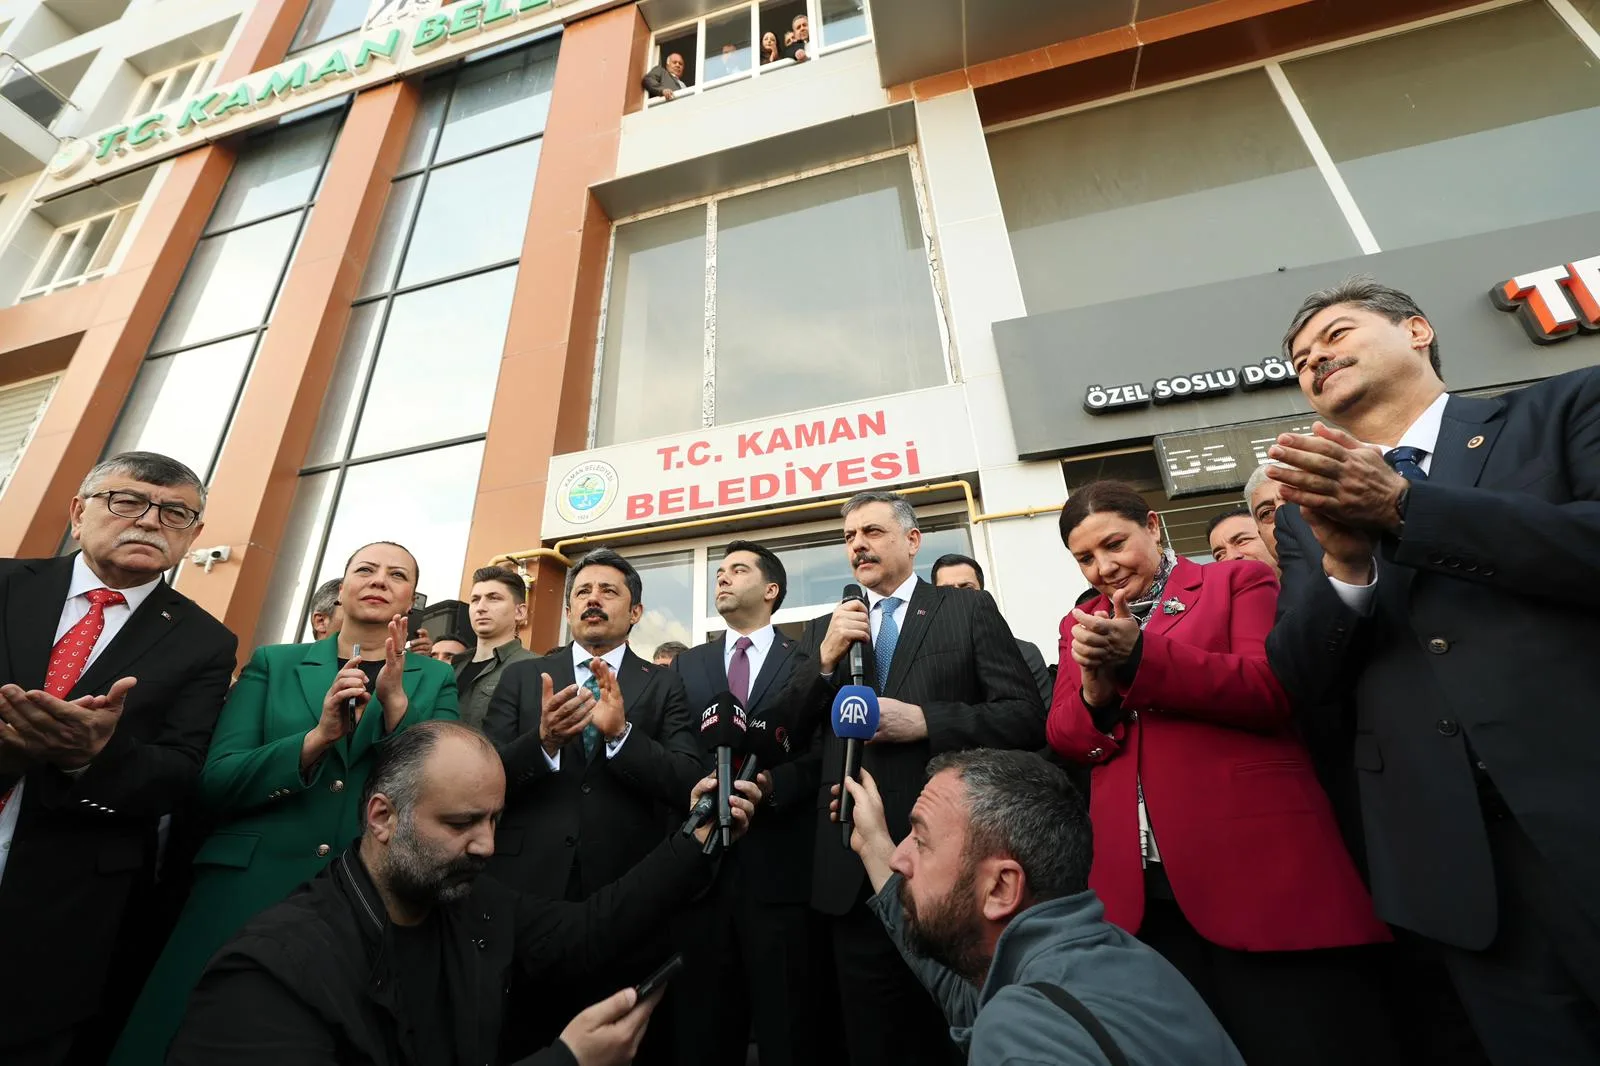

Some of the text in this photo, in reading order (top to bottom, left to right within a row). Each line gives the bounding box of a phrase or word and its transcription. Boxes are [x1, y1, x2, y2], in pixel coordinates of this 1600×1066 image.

[96, 113, 166, 160] T.C.
[176, 28, 400, 131] KAMAN
[1087, 385, 1149, 407] ÖZEL
[1156, 369, 1237, 396] SOSLU
[656, 410, 887, 471] T.C. KAMAN
[625, 440, 921, 521] BELEDİYESİ
[840, 703, 867, 725] AA
